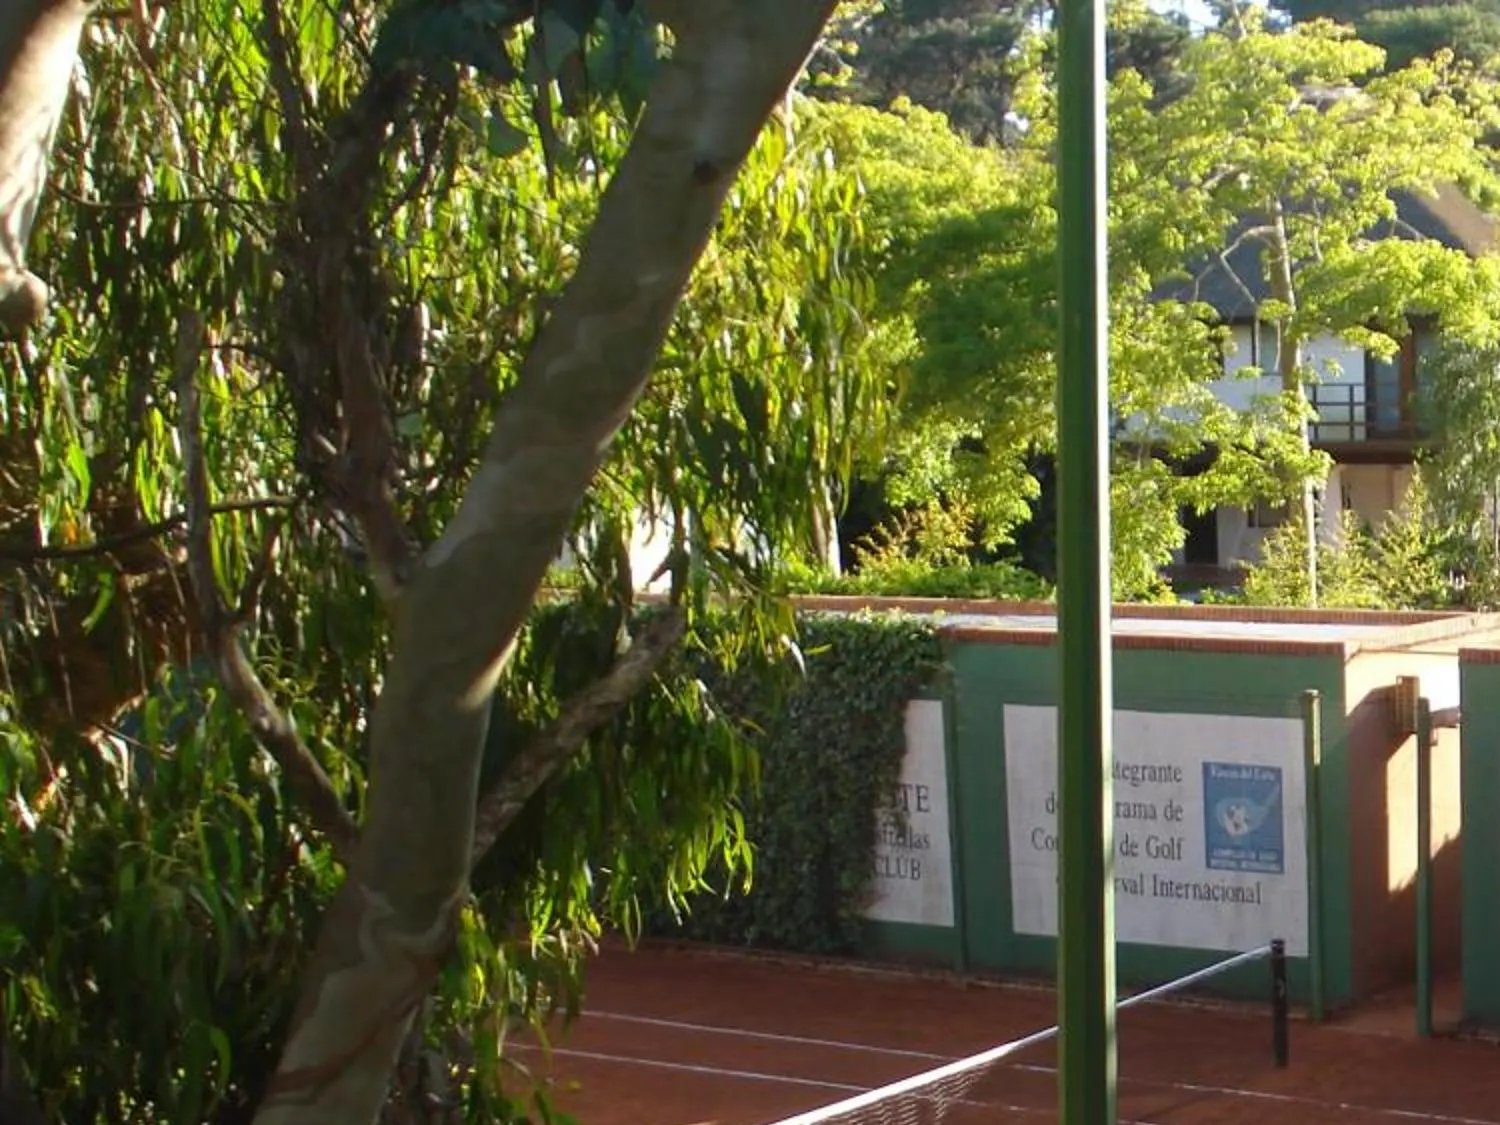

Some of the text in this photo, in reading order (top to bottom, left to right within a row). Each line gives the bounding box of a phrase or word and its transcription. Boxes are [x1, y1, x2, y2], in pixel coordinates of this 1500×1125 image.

[1112, 762, 1183, 787] tegrante
[1113, 799, 1184, 822] rama de
[1118, 832, 1140, 858] de
[1145, 835, 1185, 861] Golf
[1152, 873, 1262, 905] Internacional
